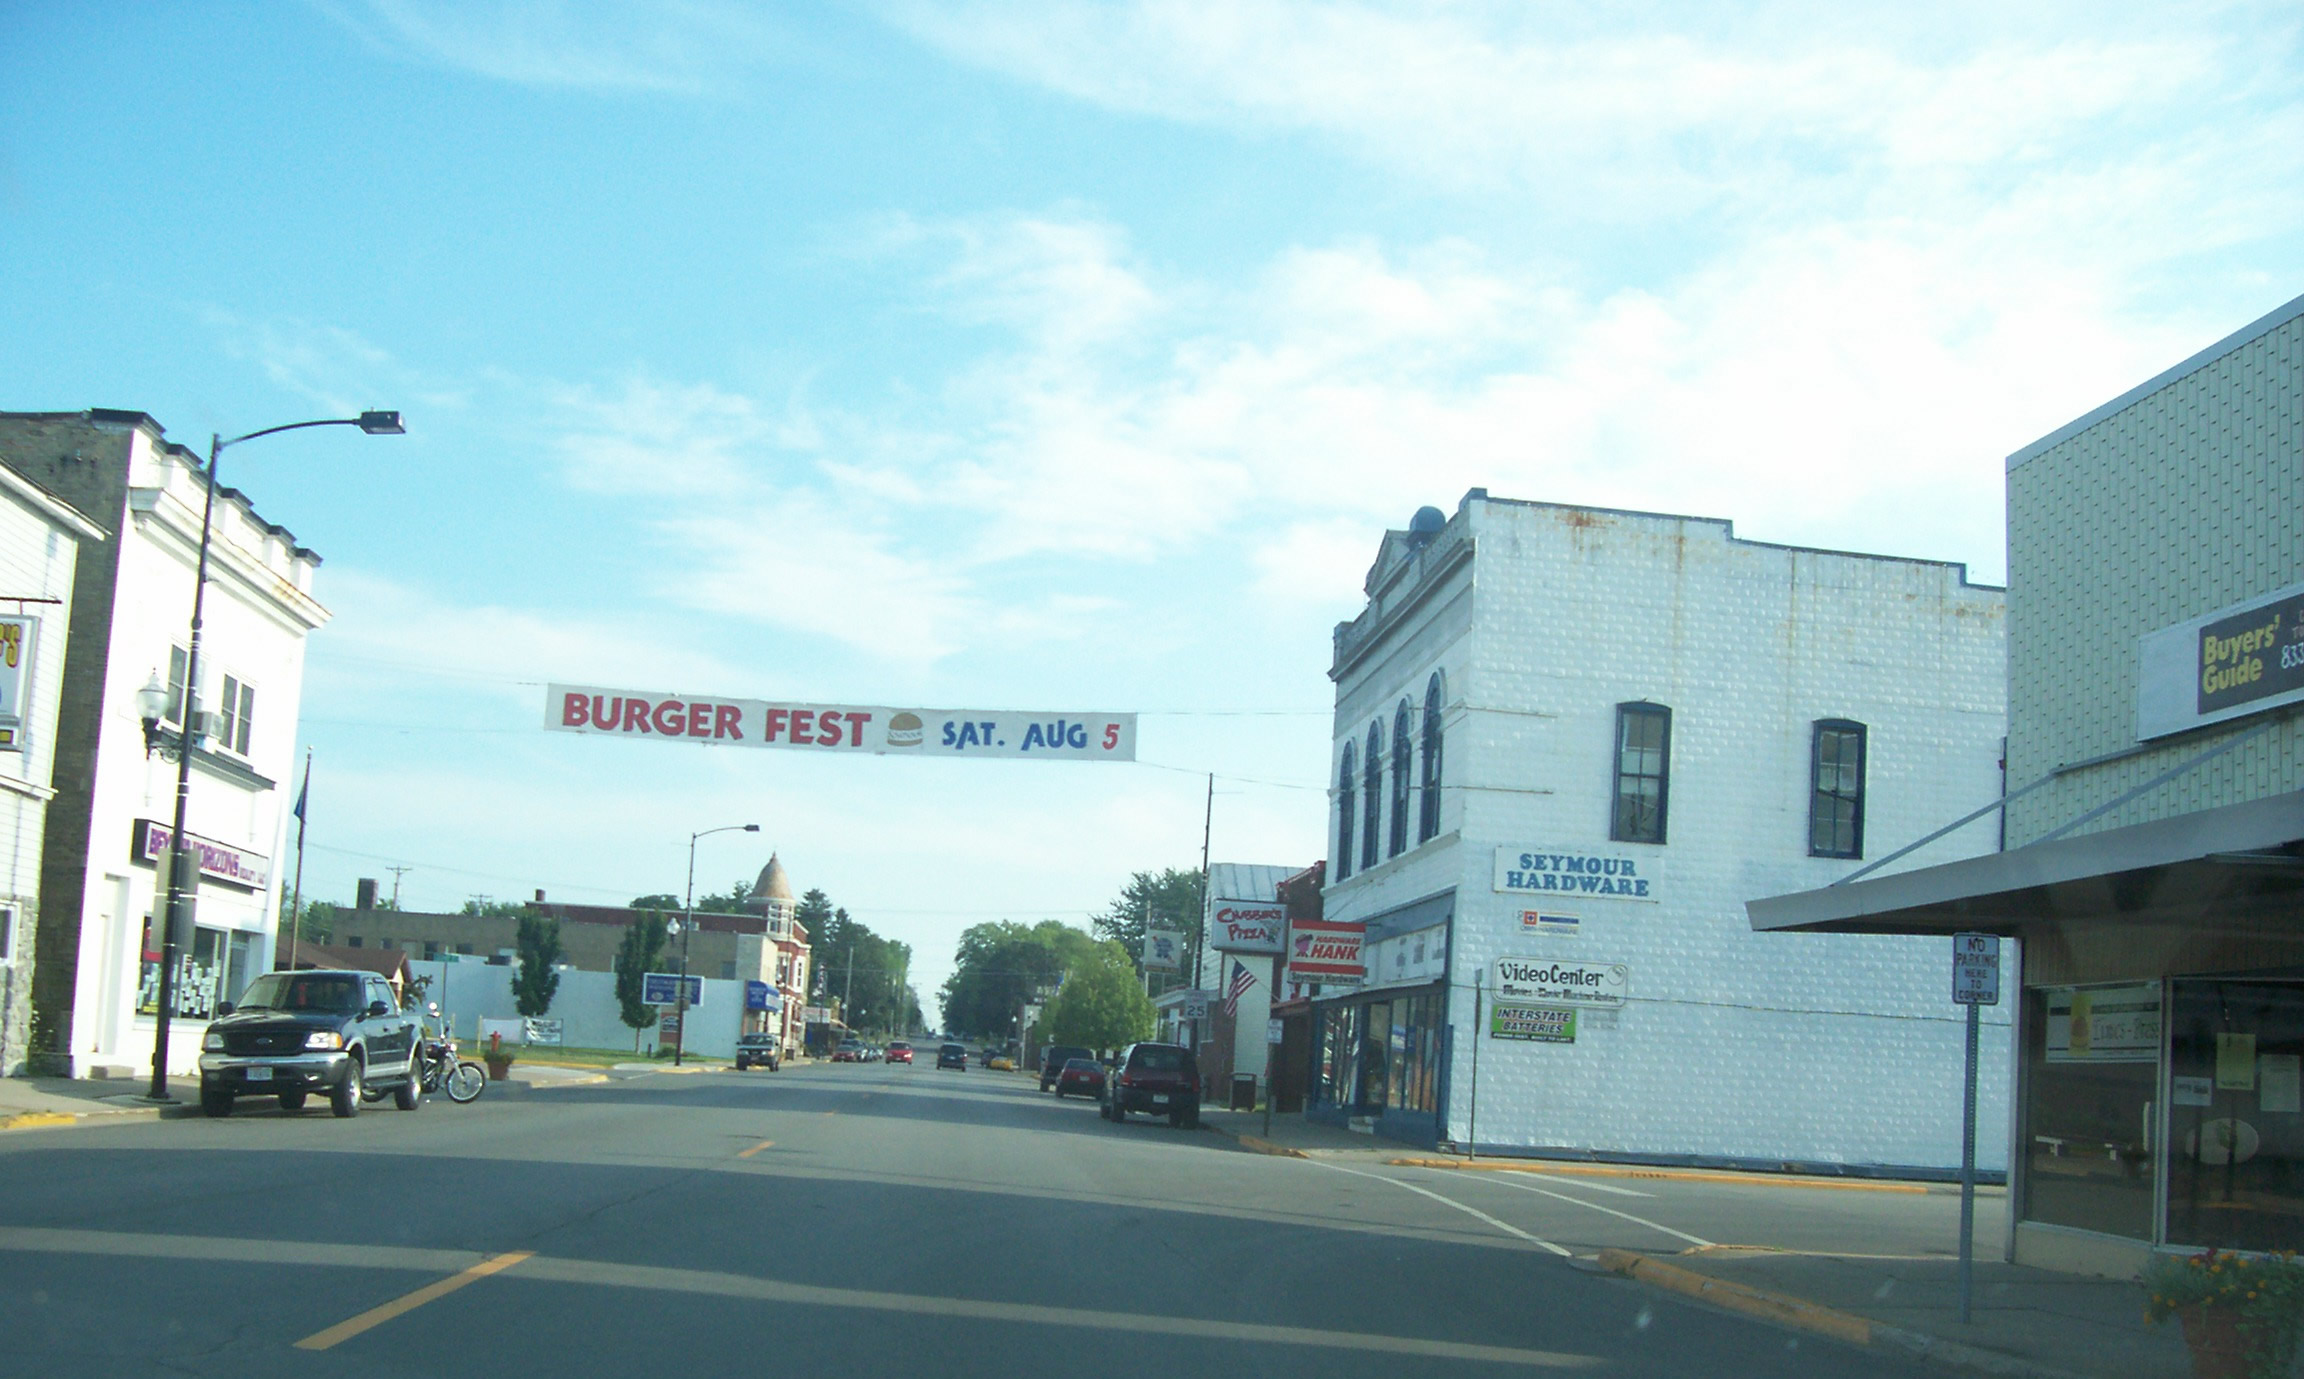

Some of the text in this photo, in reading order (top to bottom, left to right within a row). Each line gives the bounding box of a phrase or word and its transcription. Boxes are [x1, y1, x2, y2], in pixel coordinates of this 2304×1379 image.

[2204, 614, 2280, 666] Buyers'
[2203, 656, 2263, 694] Guide
[562, 692, 1120, 751] BURGER FEST SAT. AUG 5
[1519, 853, 1637, 876] SEYMOUR
[1506, 870, 1649, 897] HARDWARE
[1311, 944, 1360, 960] HANK
[1967, 937, 1986, 952] NO
[1956, 953, 1998, 968] PARKING
[1970, 979, 1982, 989] TO
[1959, 990, 1993, 1001] CORNER
[1187, 1005, 1205, 1017] 25
[1497, 1008, 1571, 1022] INTERSTATE
[1503, 1021, 1564, 1034] BATTERIES
